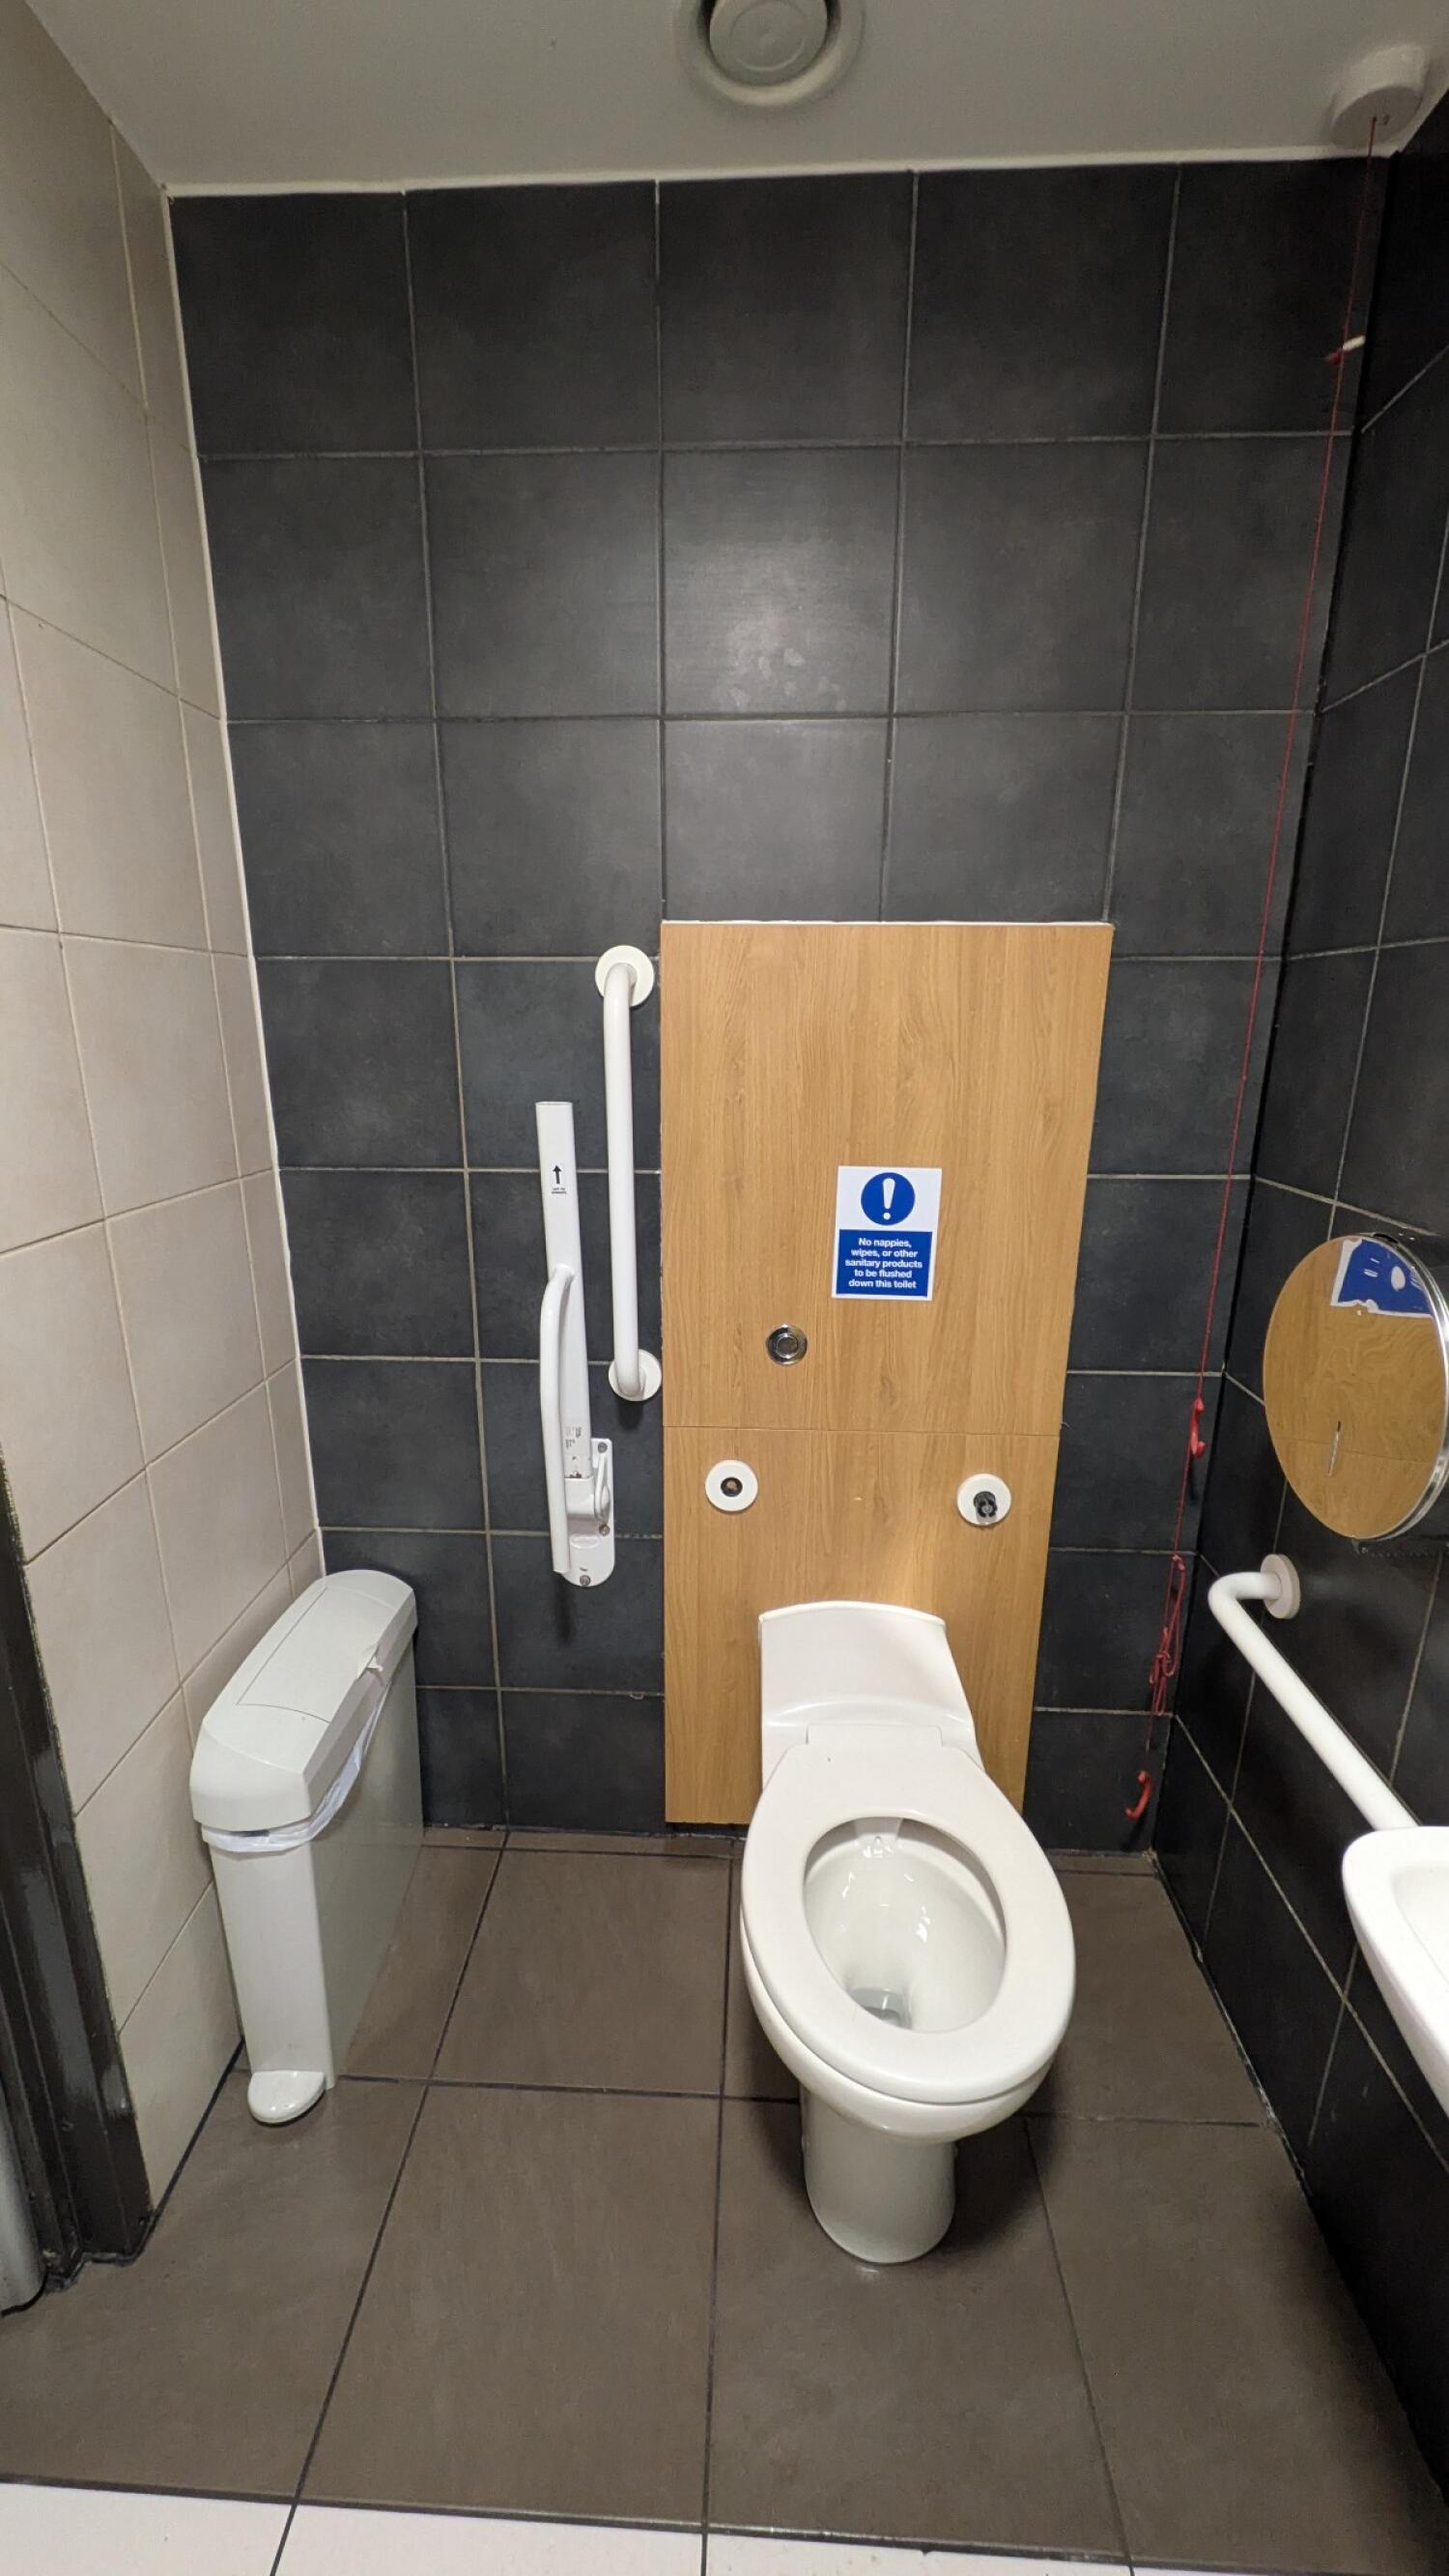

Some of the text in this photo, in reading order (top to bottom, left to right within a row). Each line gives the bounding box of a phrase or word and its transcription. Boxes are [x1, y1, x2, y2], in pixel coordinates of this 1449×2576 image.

[859, 1238, 912, 1248] No nappies,
[851, 1248, 880, 1258] wipes,
[894, 1249, 918, 1258] other
[845, 1259, 923, 1269] sanitary products
[879, 1270, 912, 1278] flushed
[848, 1278, 917, 1289] down this toilet
